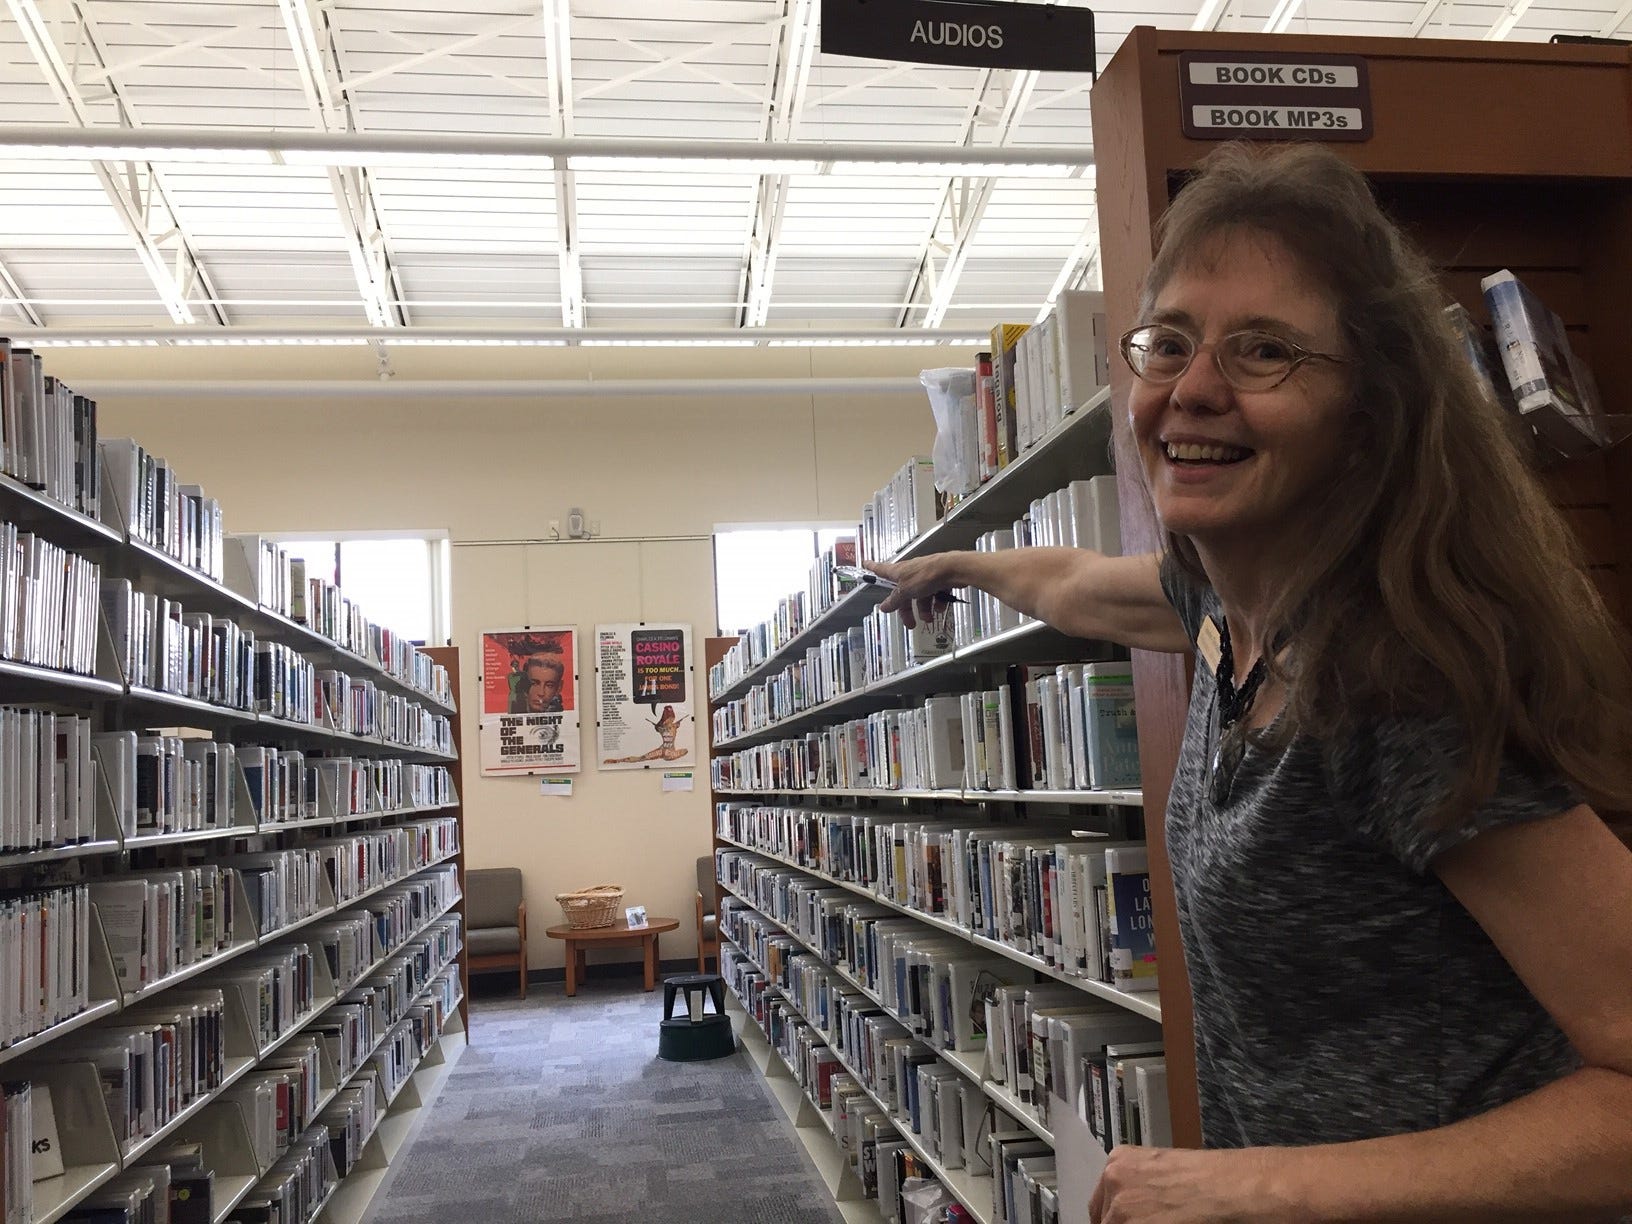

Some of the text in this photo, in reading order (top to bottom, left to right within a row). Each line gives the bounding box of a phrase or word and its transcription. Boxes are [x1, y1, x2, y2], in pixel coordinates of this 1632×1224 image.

[910, 20, 1004, 49] AUDIOS
[1216, 67, 1337, 84] BOOK CDs
[1210, 109, 1348, 128] BOOK MP3s
[635, 641, 680, 653] CASINO
[636, 654, 680, 666] ROYALE
[500, 715, 563, 726] THE NIGHT
[500, 727, 516, 736] OF
[500, 736, 524, 745] THE
[500, 744, 564, 755] GENERALS
